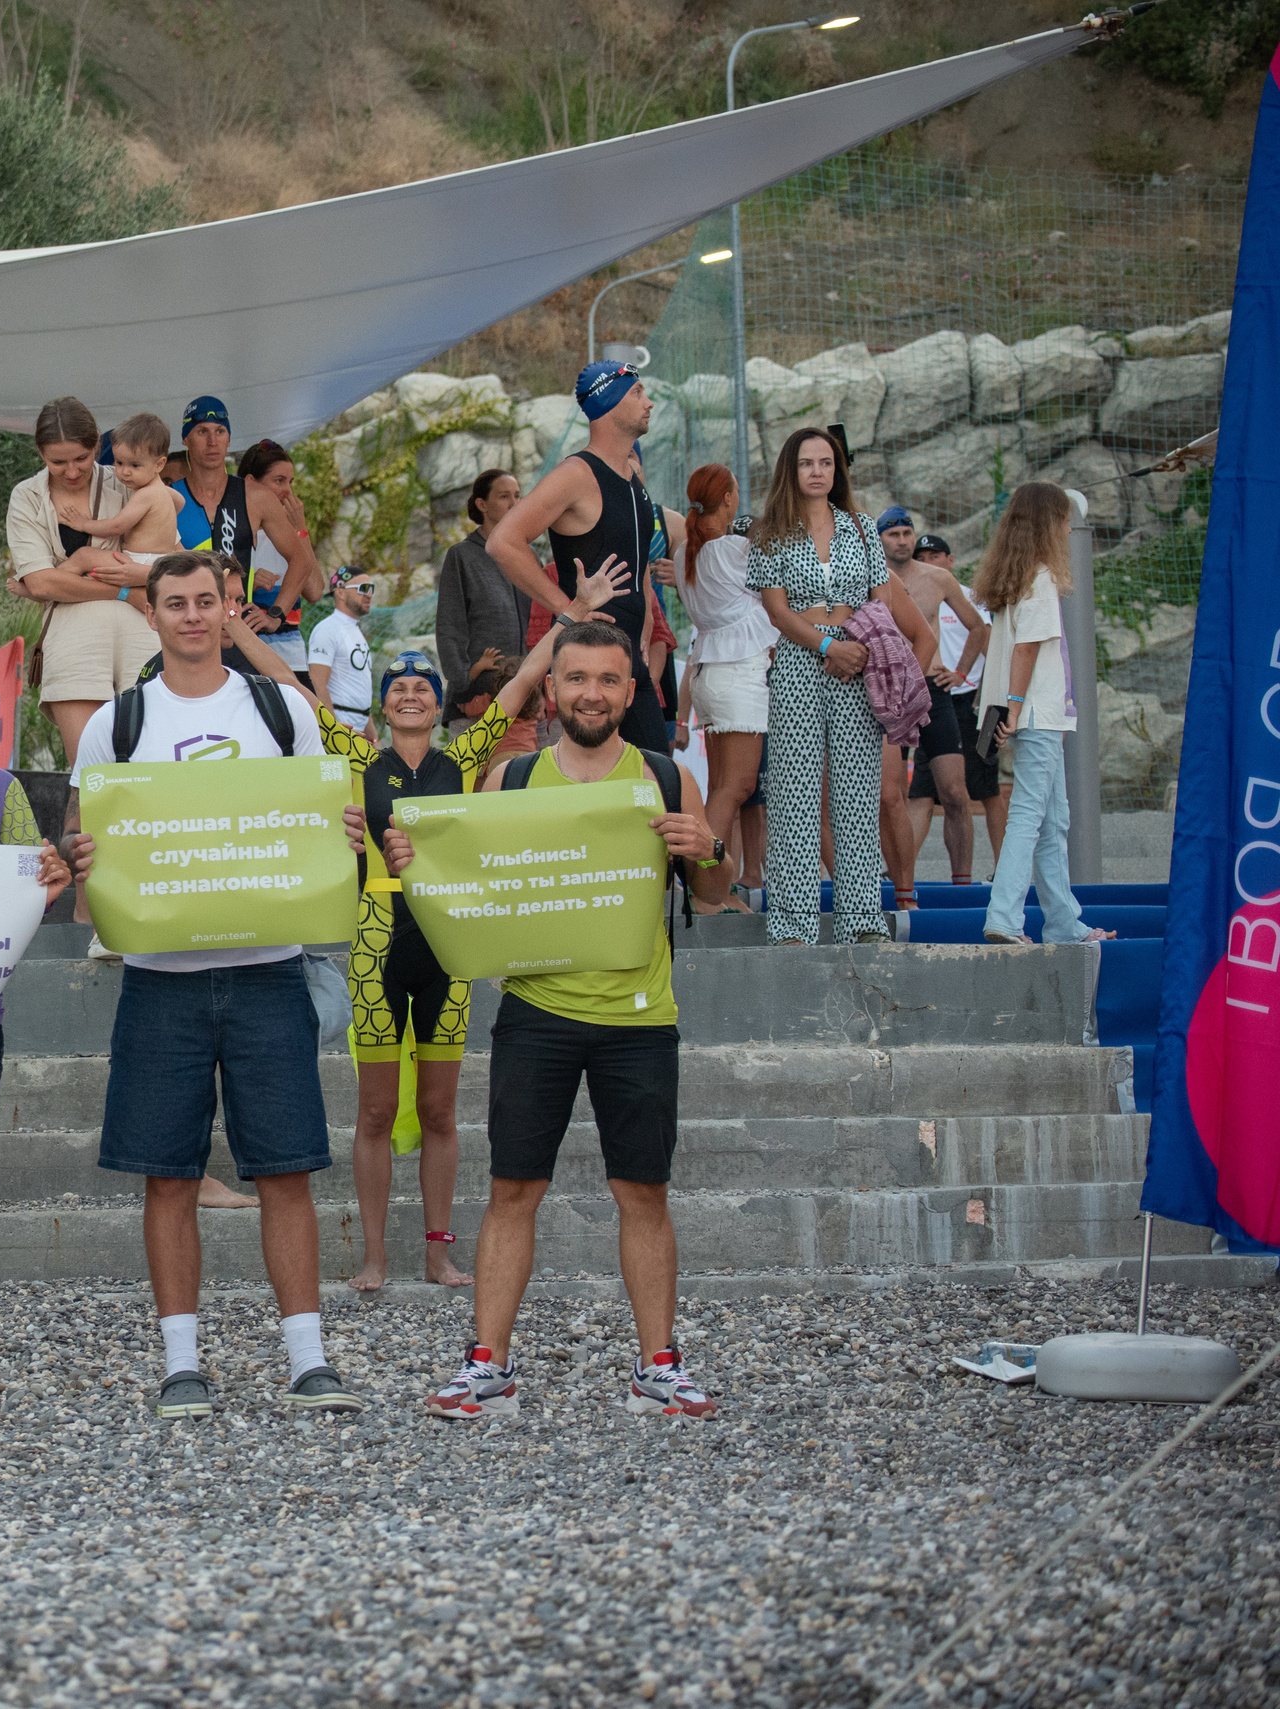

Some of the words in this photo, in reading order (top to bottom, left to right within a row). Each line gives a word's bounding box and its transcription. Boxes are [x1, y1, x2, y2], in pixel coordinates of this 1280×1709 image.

[105, 777, 132, 785] SHARUN
[106, 814, 231, 838] «Хорошая
[238, 809, 329, 834] работа,
[420, 809, 447, 817] SHARUN
[149, 840, 289, 868] случайный
[479, 845, 587, 868] Улыбнись!
[139, 874, 303, 896] незнакомец»
[412, 882, 484, 897] Помни,
[488, 878, 523, 891] что
[528, 876, 554, 889] ты
[560, 866, 657, 886] заплатил,
[448, 901, 511, 919] чтобы
[516, 898, 587, 917] делать
[591, 894, 625, 908] это
[191, 931, 256, 943] sharun.team
[507, 957, 572, 969] sharun.team
